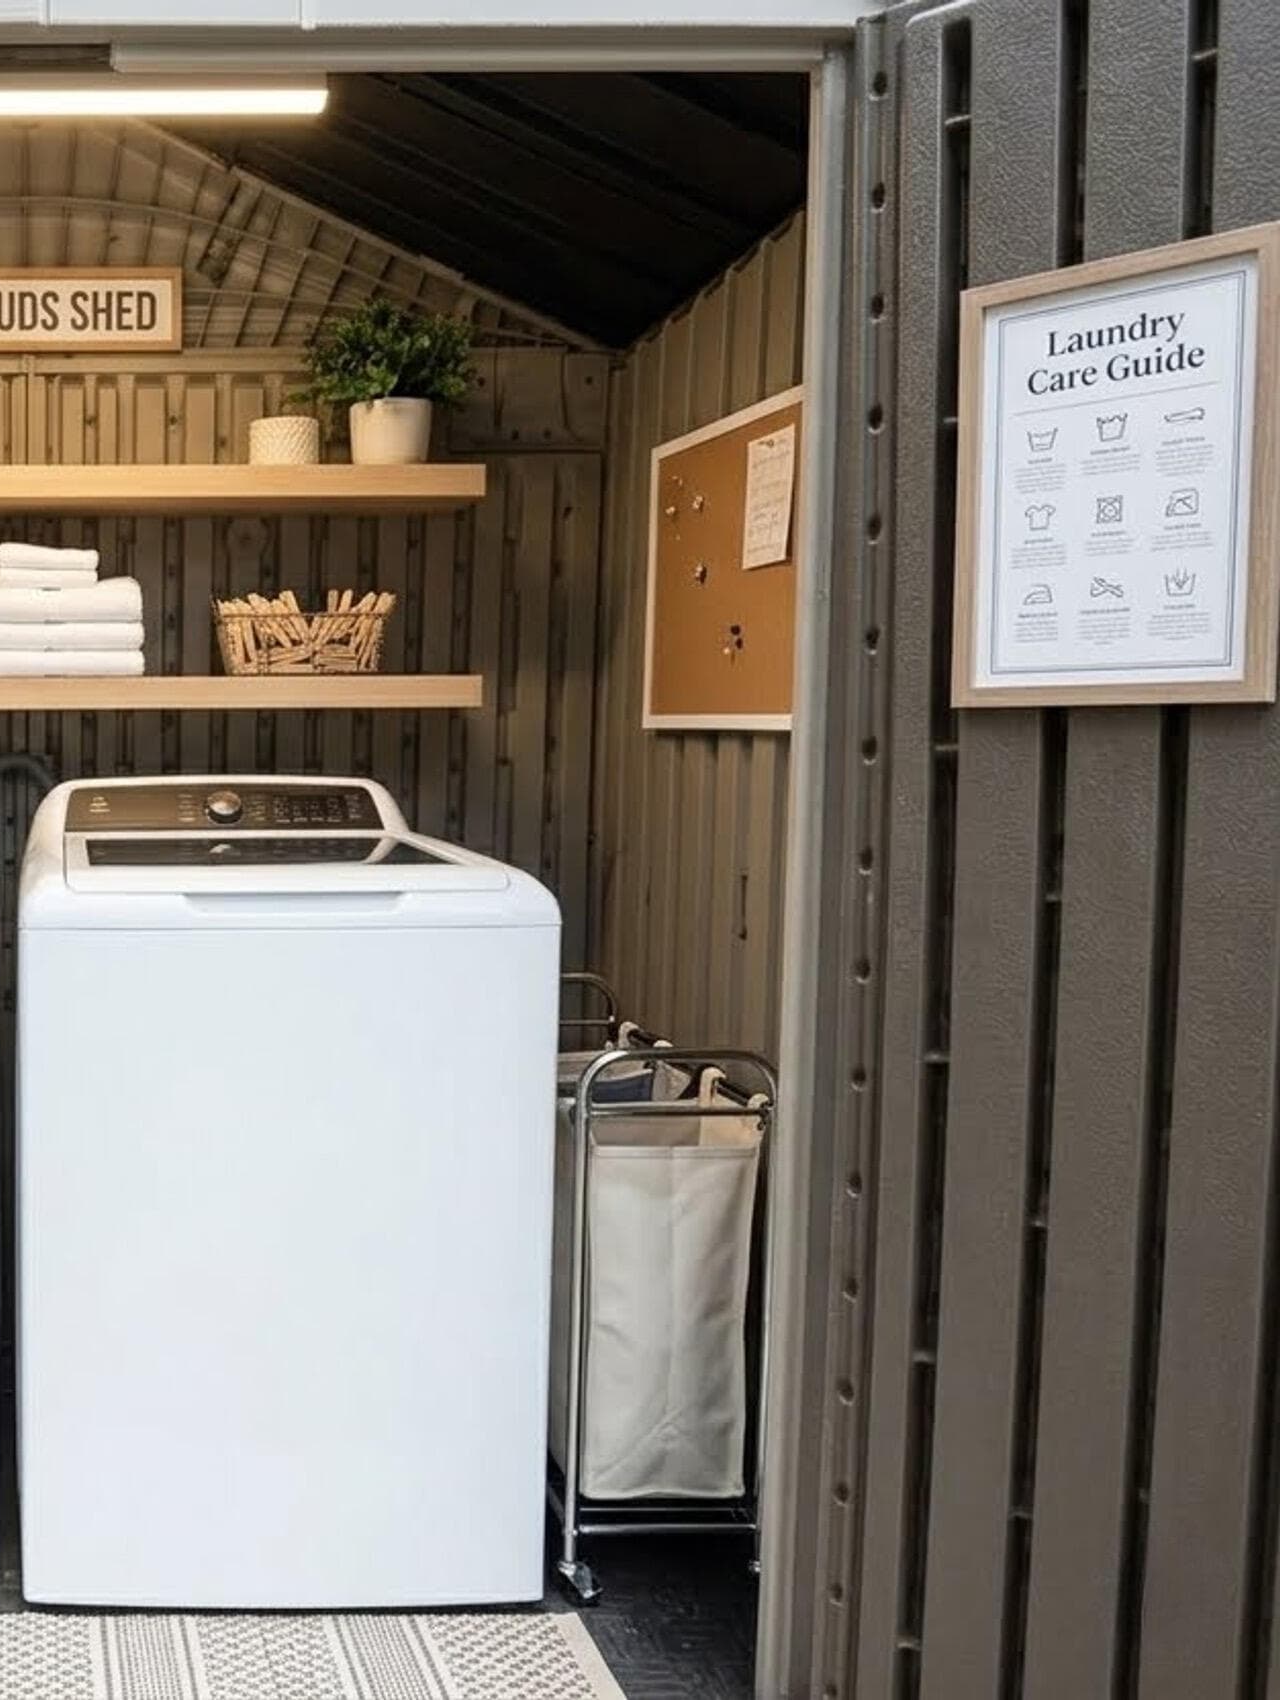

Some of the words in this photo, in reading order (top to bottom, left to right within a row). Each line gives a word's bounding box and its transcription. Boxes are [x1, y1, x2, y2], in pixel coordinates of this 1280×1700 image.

[71, 290, 157, 331] SHED
[1048, 312, 1186, 357] Laundry
[1027, 365, 1098, 395] Care
[1106, 343, 1206, 382] Guide
